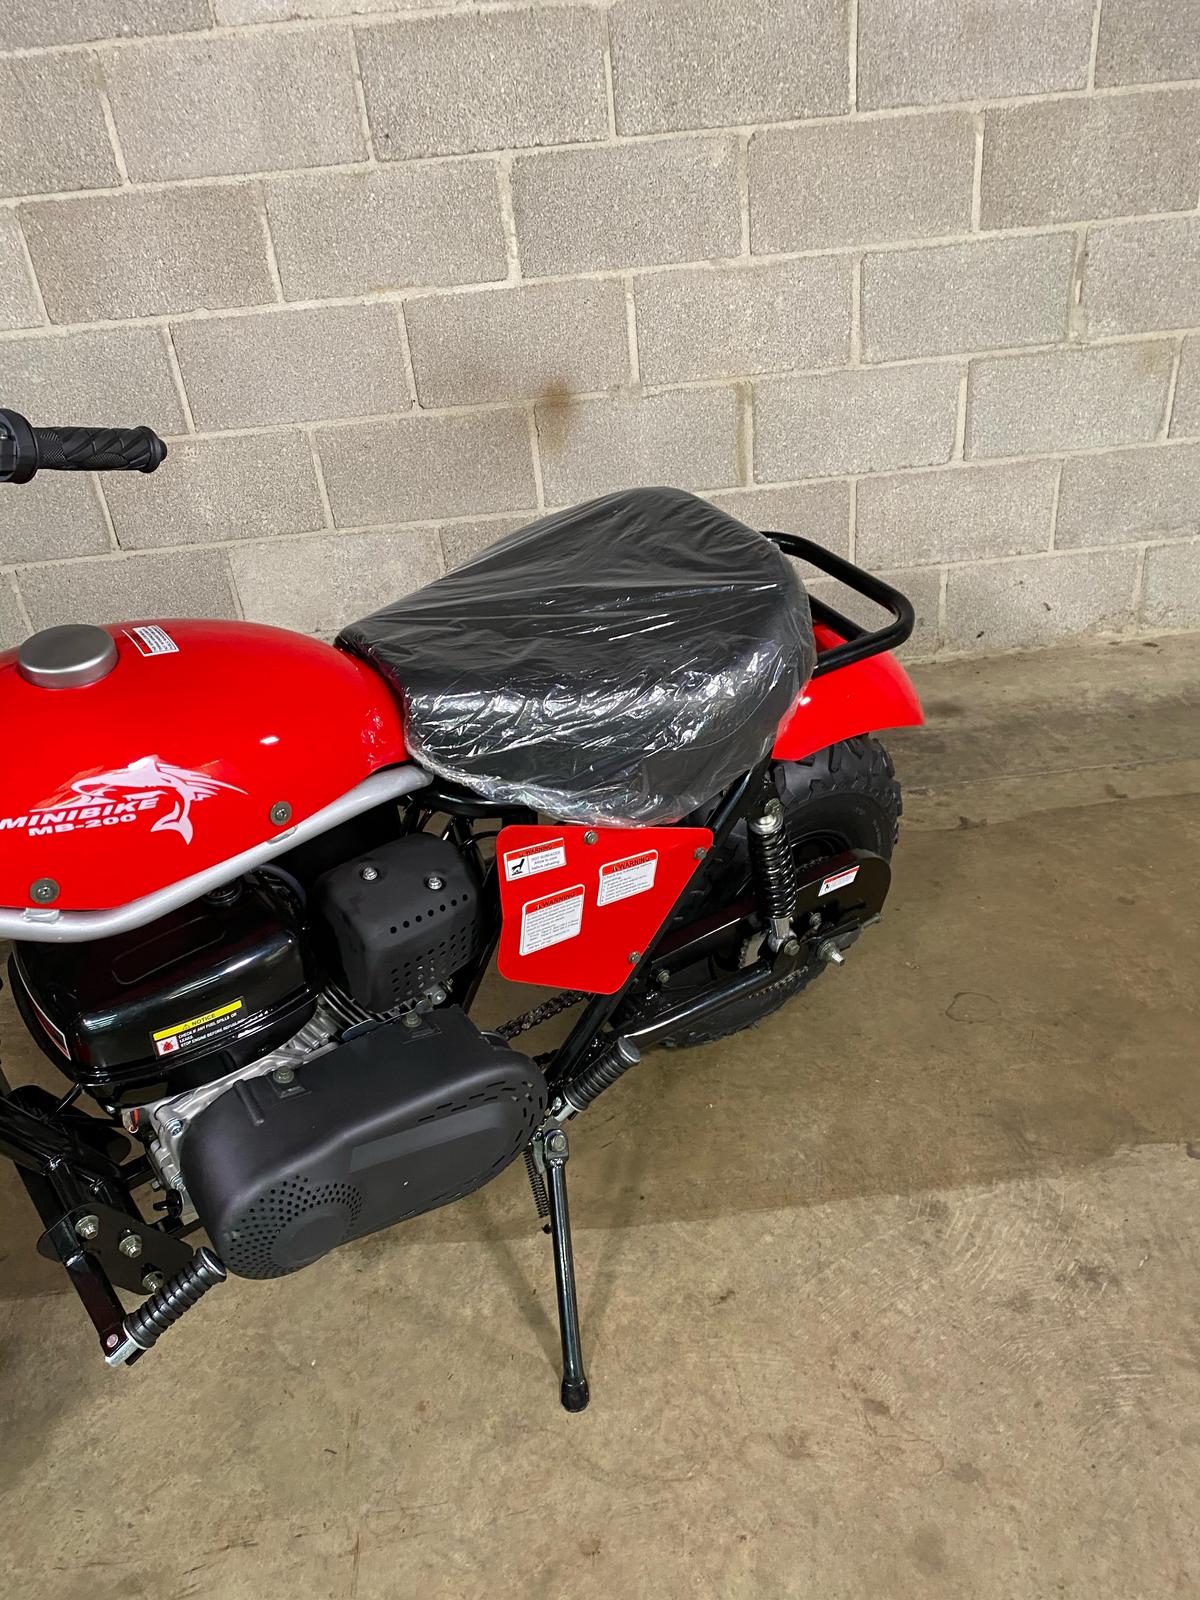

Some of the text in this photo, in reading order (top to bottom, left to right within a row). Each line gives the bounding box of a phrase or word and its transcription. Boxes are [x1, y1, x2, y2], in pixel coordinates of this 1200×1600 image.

[0, 797, 159, 830] MINIBIKE
[28, 814, 137, 836] MB-200
[620, 856, 650, 870] WARNING
[544, 892, 576, 907] WARNING
[191, 1013, 216, 1027] NOTICE
[178, 1030, 192, 1039] CHECK
[206, 1021, 217, 1029] FUEL
